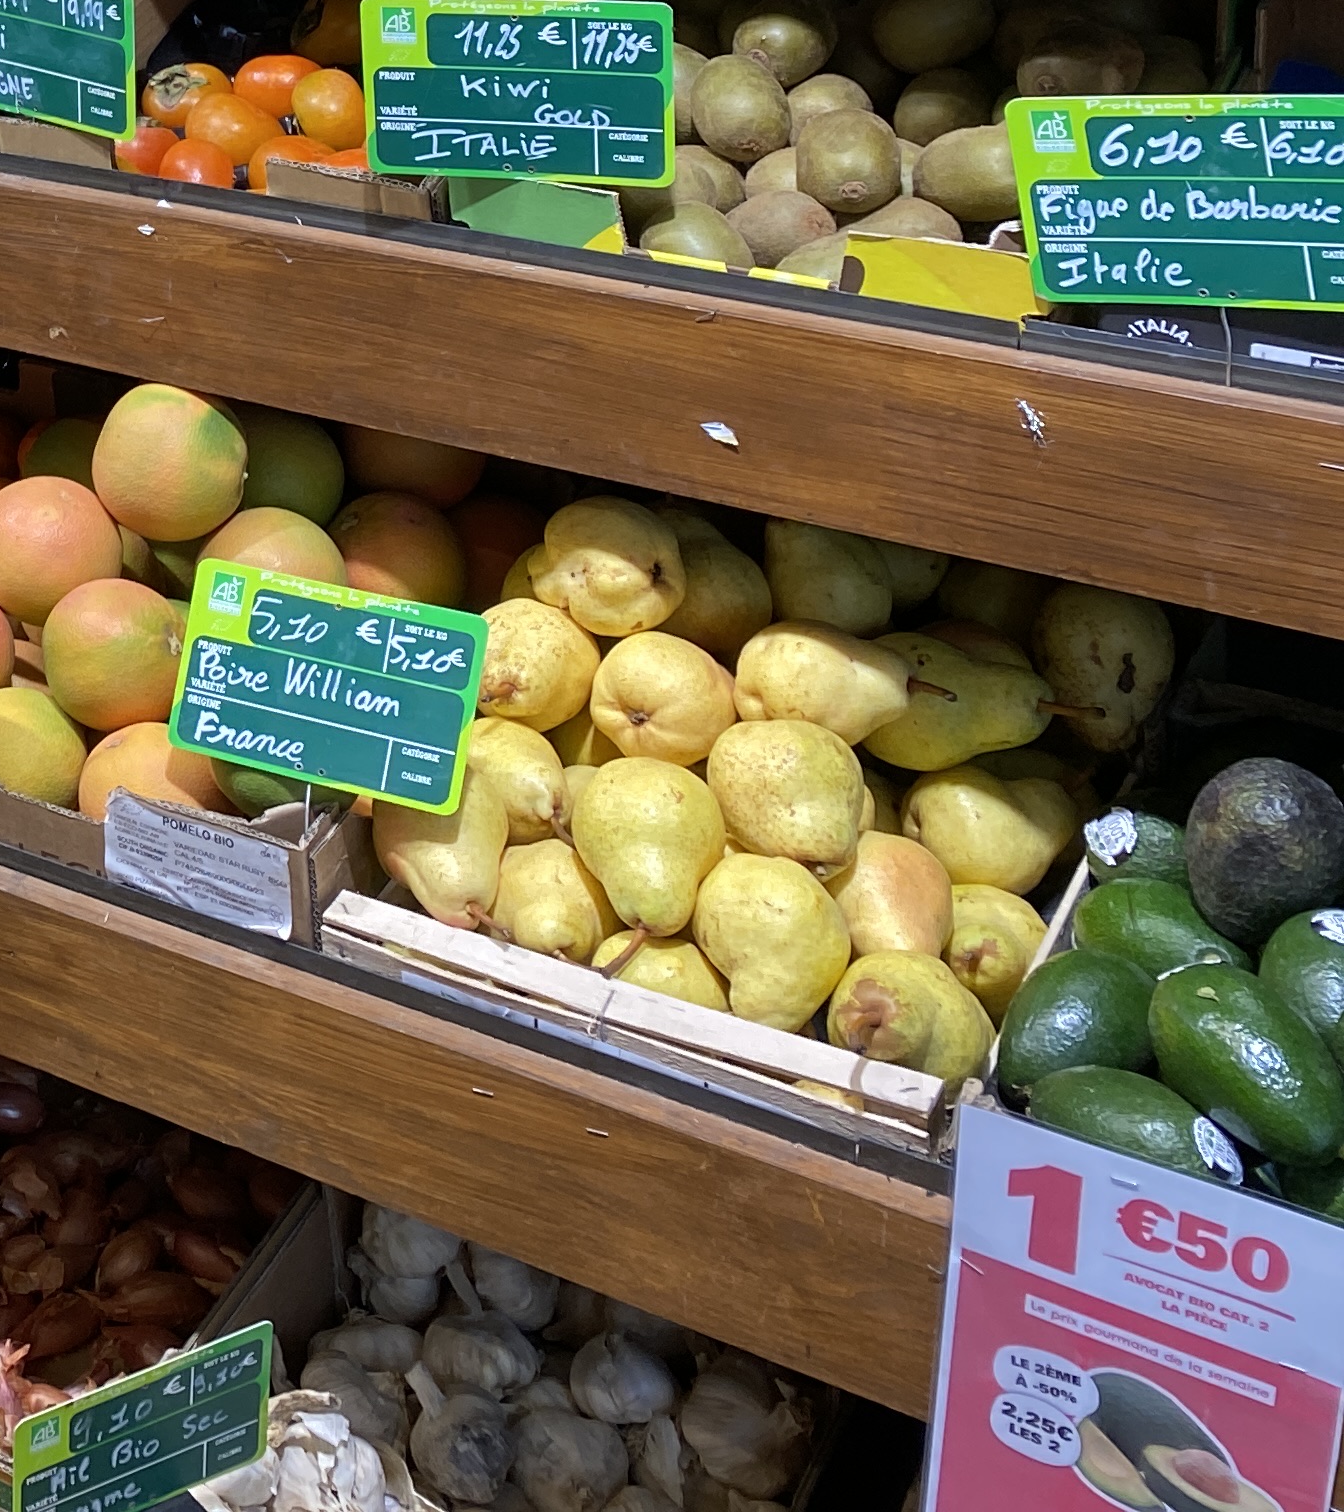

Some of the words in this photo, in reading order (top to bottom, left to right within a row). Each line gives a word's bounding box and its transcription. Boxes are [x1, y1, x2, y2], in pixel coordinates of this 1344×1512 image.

[541, 0, 602, 15] planète
[454, 19, 523, 60] 11,25
[378, 71, 416, 82] PRODUIT
[460, 75, 551, 99] Kiwi
[379, 104, 418, 117] VARIÉTÉ
[533, 103, 611, 129] GOLD
[1222, 100, 1294, 113] planète
[380, 121, 417, 133] ORIGINE
[412, 128, 558, 162] ITALIE
[612, 153, 645, 164] CALIBRE
[1036, 185, 1080, 195] PRODUIT
[1039, 192, 1129, 235] Figue
[1140, 188, 1176, 222] de
[1187, 183, 1342, 223] Barbarie
[1041, 225, 1088, 235] VARIÉTÉ
[1045, 244, 1088, 254] ORIGINE
[1057, 248, 1193, 288] Italie
[197, 640, 233, 657] PRODUIT
[190, 678, 227, 694] VARIÉTÉ
[199, 651, 269, 693] Poire
[284, 658, 400, 718] William
[187, 694, 222, 711] ORIGINE
[193, 713, 305, 764] France
[162, 816, 211, 840] POMELO
[214, 832, 235, 849] BIO
[1008, 1165, 1083, 1275] 1
[1116, 1198, 1291, 1294] €50
[1123, 1272, 1184, 1303] AVOCAT
[1187, 1292, 1216, 1312] BIO
[1219, 1304, 1255, 1328] CAT.
[1258, 1318, 1271, 1333] 2
[1160, 1299, 1181, 1315] LA
[1184, 1306, 1228, 1333] PIÈCE
[1029, 1300, 1046, 1316] Le
[1050, 1308, 1079, 1329] prix
[1083, 1321, 1160, 1359] gourmand
[1164, 1349, 1184, 1366] de
[1187, 1355, 1203, 1374] la
[1206, 1368, 1271, 1400] semaine
[1010, 1355, 1031, 1371] LE
[1034, 1359, 1083, 1388] 2ÈME
[1015, 1374, 1028, 1389] À
[1032, 1382, 1078, 1404] -50%
[110, 1436, 161, 1470] Bio
[181, 1406, 231, 1439] Sec
[1008, 1423, 1043, 1446] LES
[1048, 1437, 1062, 1454] 2
